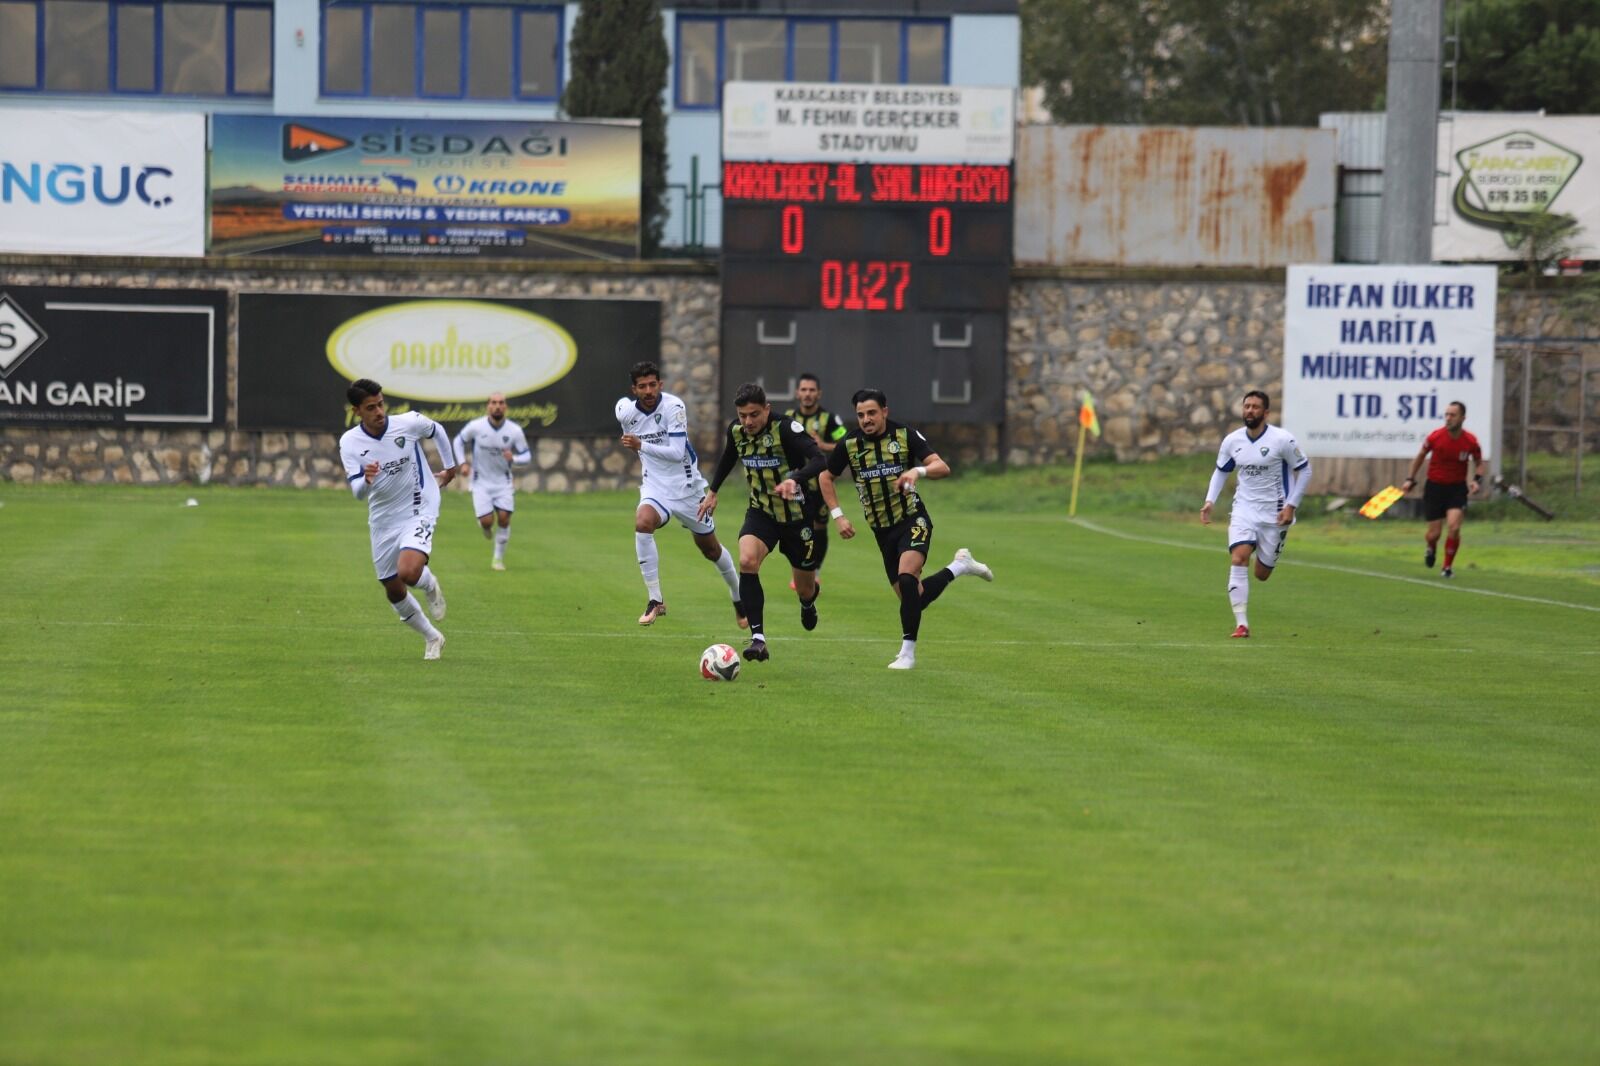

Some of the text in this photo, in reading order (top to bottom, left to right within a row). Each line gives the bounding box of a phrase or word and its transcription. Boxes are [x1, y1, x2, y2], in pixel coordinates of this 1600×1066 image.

[774, 88, 869, 104] KARACABEY
[776, 109, 797, 125] M.
[862, 110, 960, 131] GERÇEKER
[360, 126, 568, 157] SİSDAĞI
[818, 133, 918, 152] STADYUMU
[467, 180, 568, 196] KRONE
[292, 204, 560, 225] YETKİLİ SERVİS & YEDEK PARÇA
[781, 205, 804, 254] 0
[928, 207, 951, 256] 0
[821, 260, 911, 310] 01:27
[1306, 277, 1475, 310] İRFAN ÜLKER
[1340, 313, 1436, 344] HARİTA
[1301, 350, 1475, 381] MÜHENDİSLİK
[45, 377, 146, 408] GARİP
[1337, 394, 1389, 419] LTD.
[414, 526, 432, 541] 27
[804, 540, 815, 560] 7
